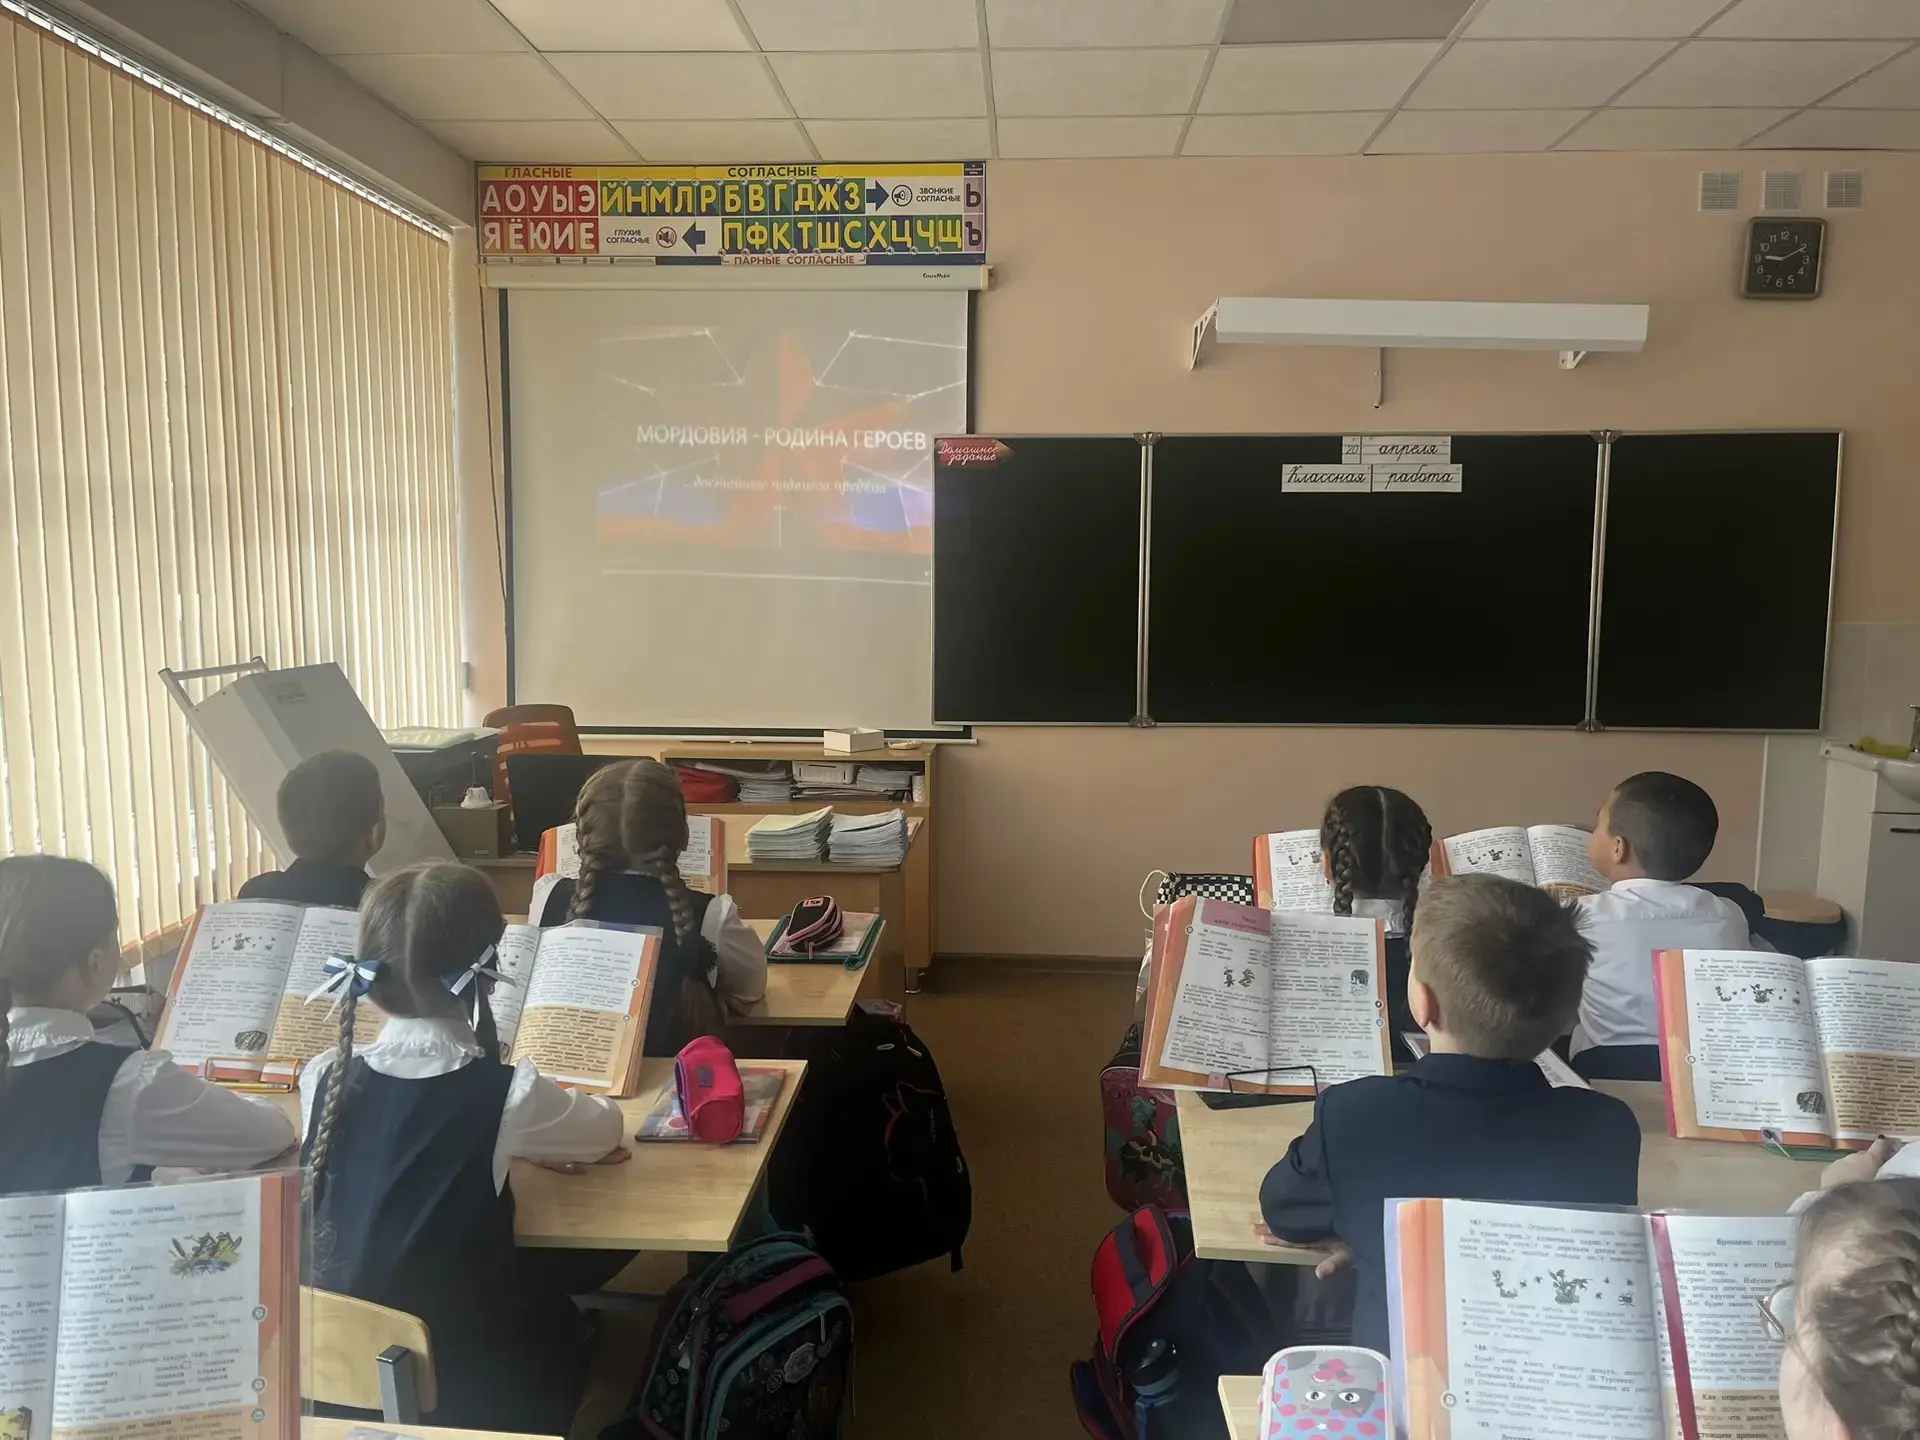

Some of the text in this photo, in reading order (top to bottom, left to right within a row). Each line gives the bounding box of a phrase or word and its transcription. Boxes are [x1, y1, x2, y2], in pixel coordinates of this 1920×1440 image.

[505, 167, 572, 178] ГЛАСНЫЕ
[728, 166, 817, 178] СОГЛАСНЫЕ
[966, 183, 982, 207] Ь
[965, 221, 982, 246] Ъ
[1780, 231, 1790, 240] 12
[1769, 234, 1777, 243] 11
[1794, 235, 1798, 243] 1
[1760, 243, 1770, 252] 10
[1800, 244, 1807, 253] 2
[734, 256, 854, 265] ПАРНЫЕ СОГЛАСНЫЕ
[1755, 254, 1761, 263] 9
[1802, 255, 1810, 264] 3
[1756, 265, 1764, 274] 8
[1798, 267, 1804, 275] 4
[1766, 275, 1772, 283] 7
[1776, 278, 1783, 287] 6
[1788, 275, 1795, 285] 5
[636, 425, 747, 446] МОРДОВИЯ
[764, 427, 847, 450] РОДИНА
[854, 429, 926, 450] ГЕРОЕВ
[938, 441, 998, 454] Домашнее
[1346, 444, 1439, 462] 20 апреля
[948, 453, 996, 466] задание
[1287, 464, 1454, 490] Классная работа
